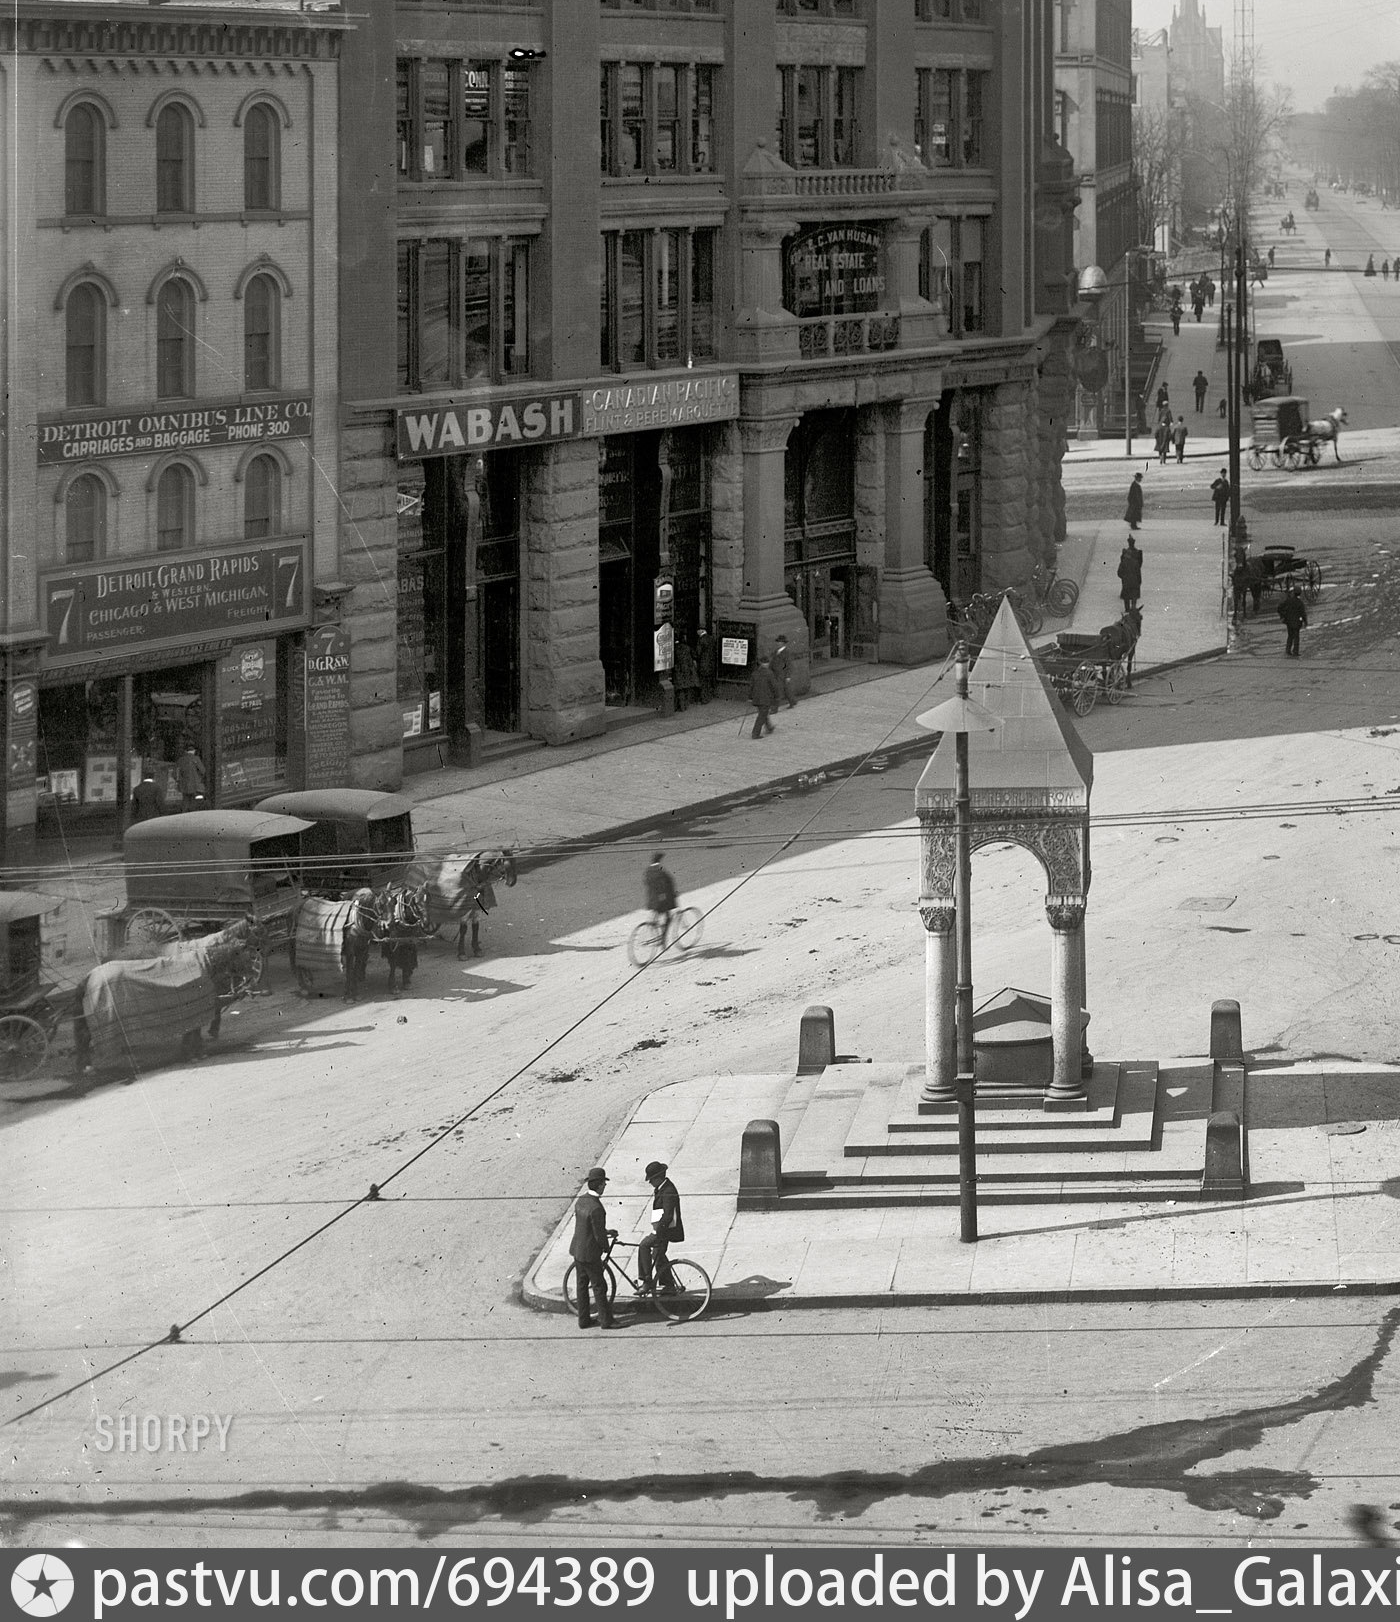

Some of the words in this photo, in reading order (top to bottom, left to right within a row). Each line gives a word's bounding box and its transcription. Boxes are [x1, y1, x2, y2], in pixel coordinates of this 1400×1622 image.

[805, 254, 829, 270] REAL
[833, 252, 865, 269] ESTATE
[825, 279, 844, 297] AND
[853, 276, 885, 294] LOANS
[592, 385, 671, 412] CANADIAN
[676, 378, 731, 402] PACIFIC
[43, 419, 131, 443] DETROIT
[138, 409, 227, 433] OMNIBUS
[235, 404, 279, 425] LINE
[63, 435, 134, 458] CARRIAGES
[134, 436, 152, 448] AND
[154, 428, 211, 448] BAGGAGE
[267, 420, 290, 436] 300
[405, 399, 573, 451] WABASH
[585, 414, 622, 433] FLINT
[623, 413, 633, 426] &
[157, 564, 204, 589] GRAND
[209, 555, 260, 583] RAPIDS
[278, 555, 300, 607] 7
[89, 603, 149, 625] CHICAGO
[153, 601, 163, 614] &
[165, 595, 201, 612] WEST
[151, 590, 159, 601] &
[51, 588, 75, 645] 7
[321, 633, 336, 655] 7
[926, 793, 951, 807] FOR
